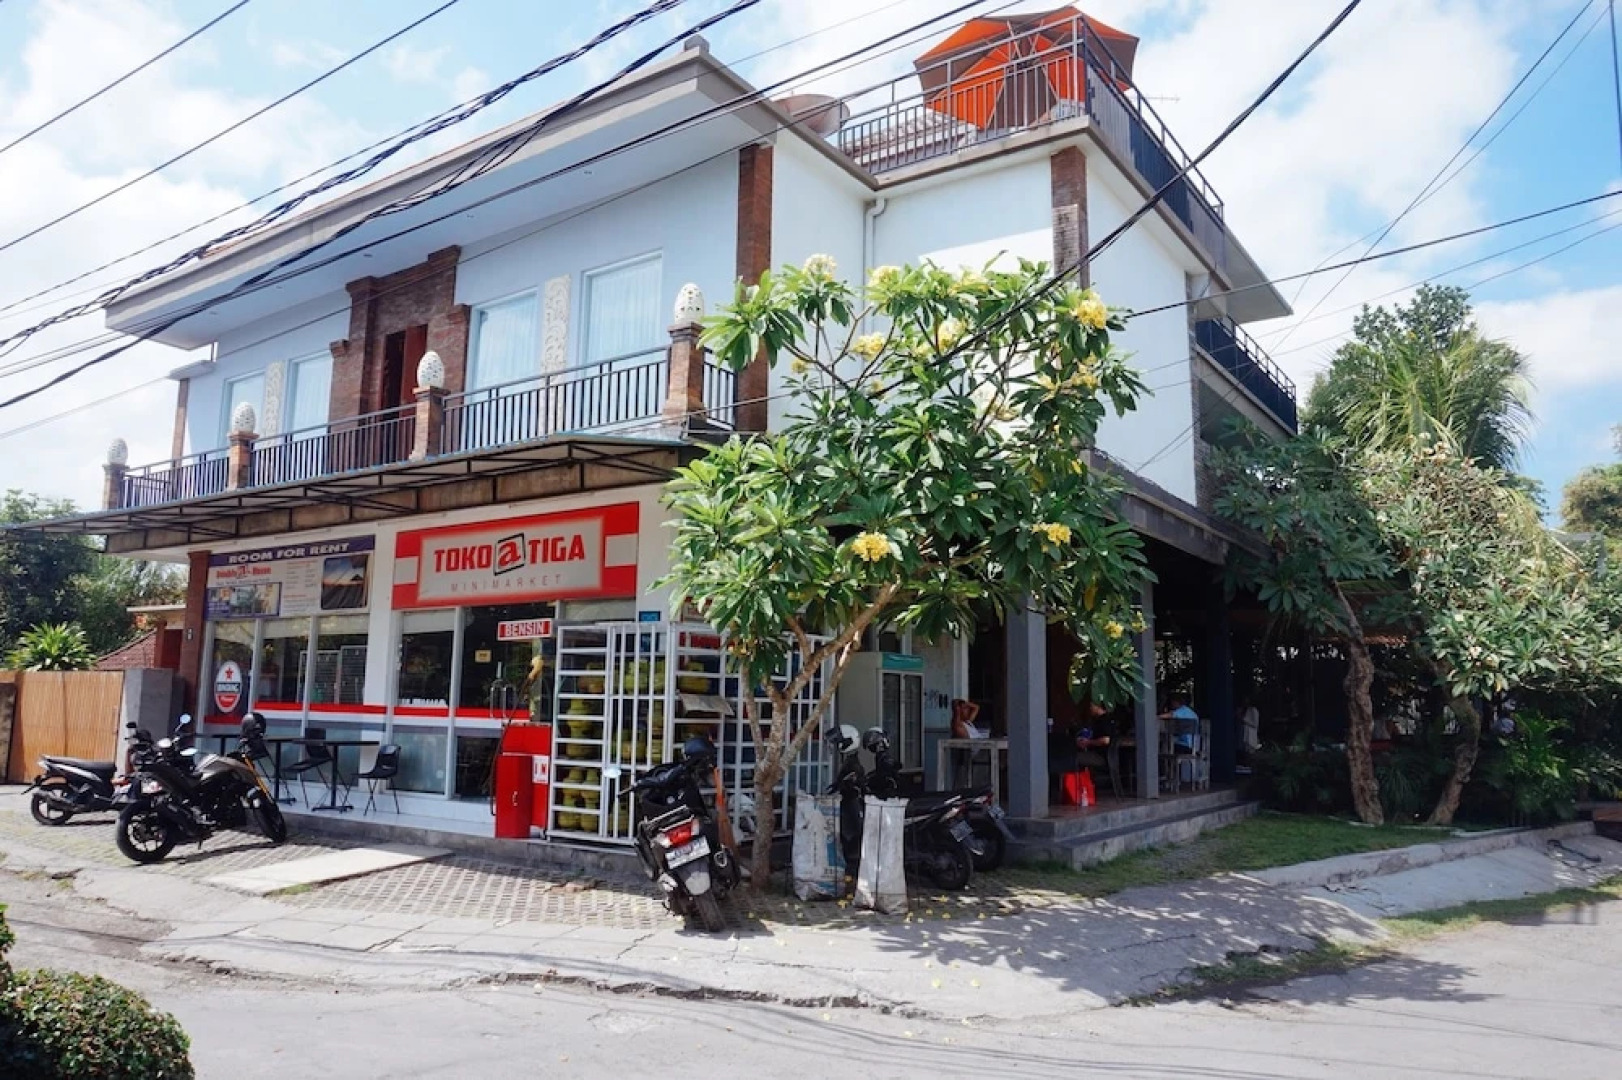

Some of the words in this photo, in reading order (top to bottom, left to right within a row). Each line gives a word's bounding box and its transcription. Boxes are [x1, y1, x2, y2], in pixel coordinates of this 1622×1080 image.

[228, 551, 273, 564] ROOM
[277, 547, 306, 559] FOR
[310, 542, 349, 556] RENT
[434, 544, 492, 573] TOKO
[528, 534, 585, 564] TIGA
[451, 574, 562, 592] MINIMARKET
[504, 620, 545, 637] BENSIN
